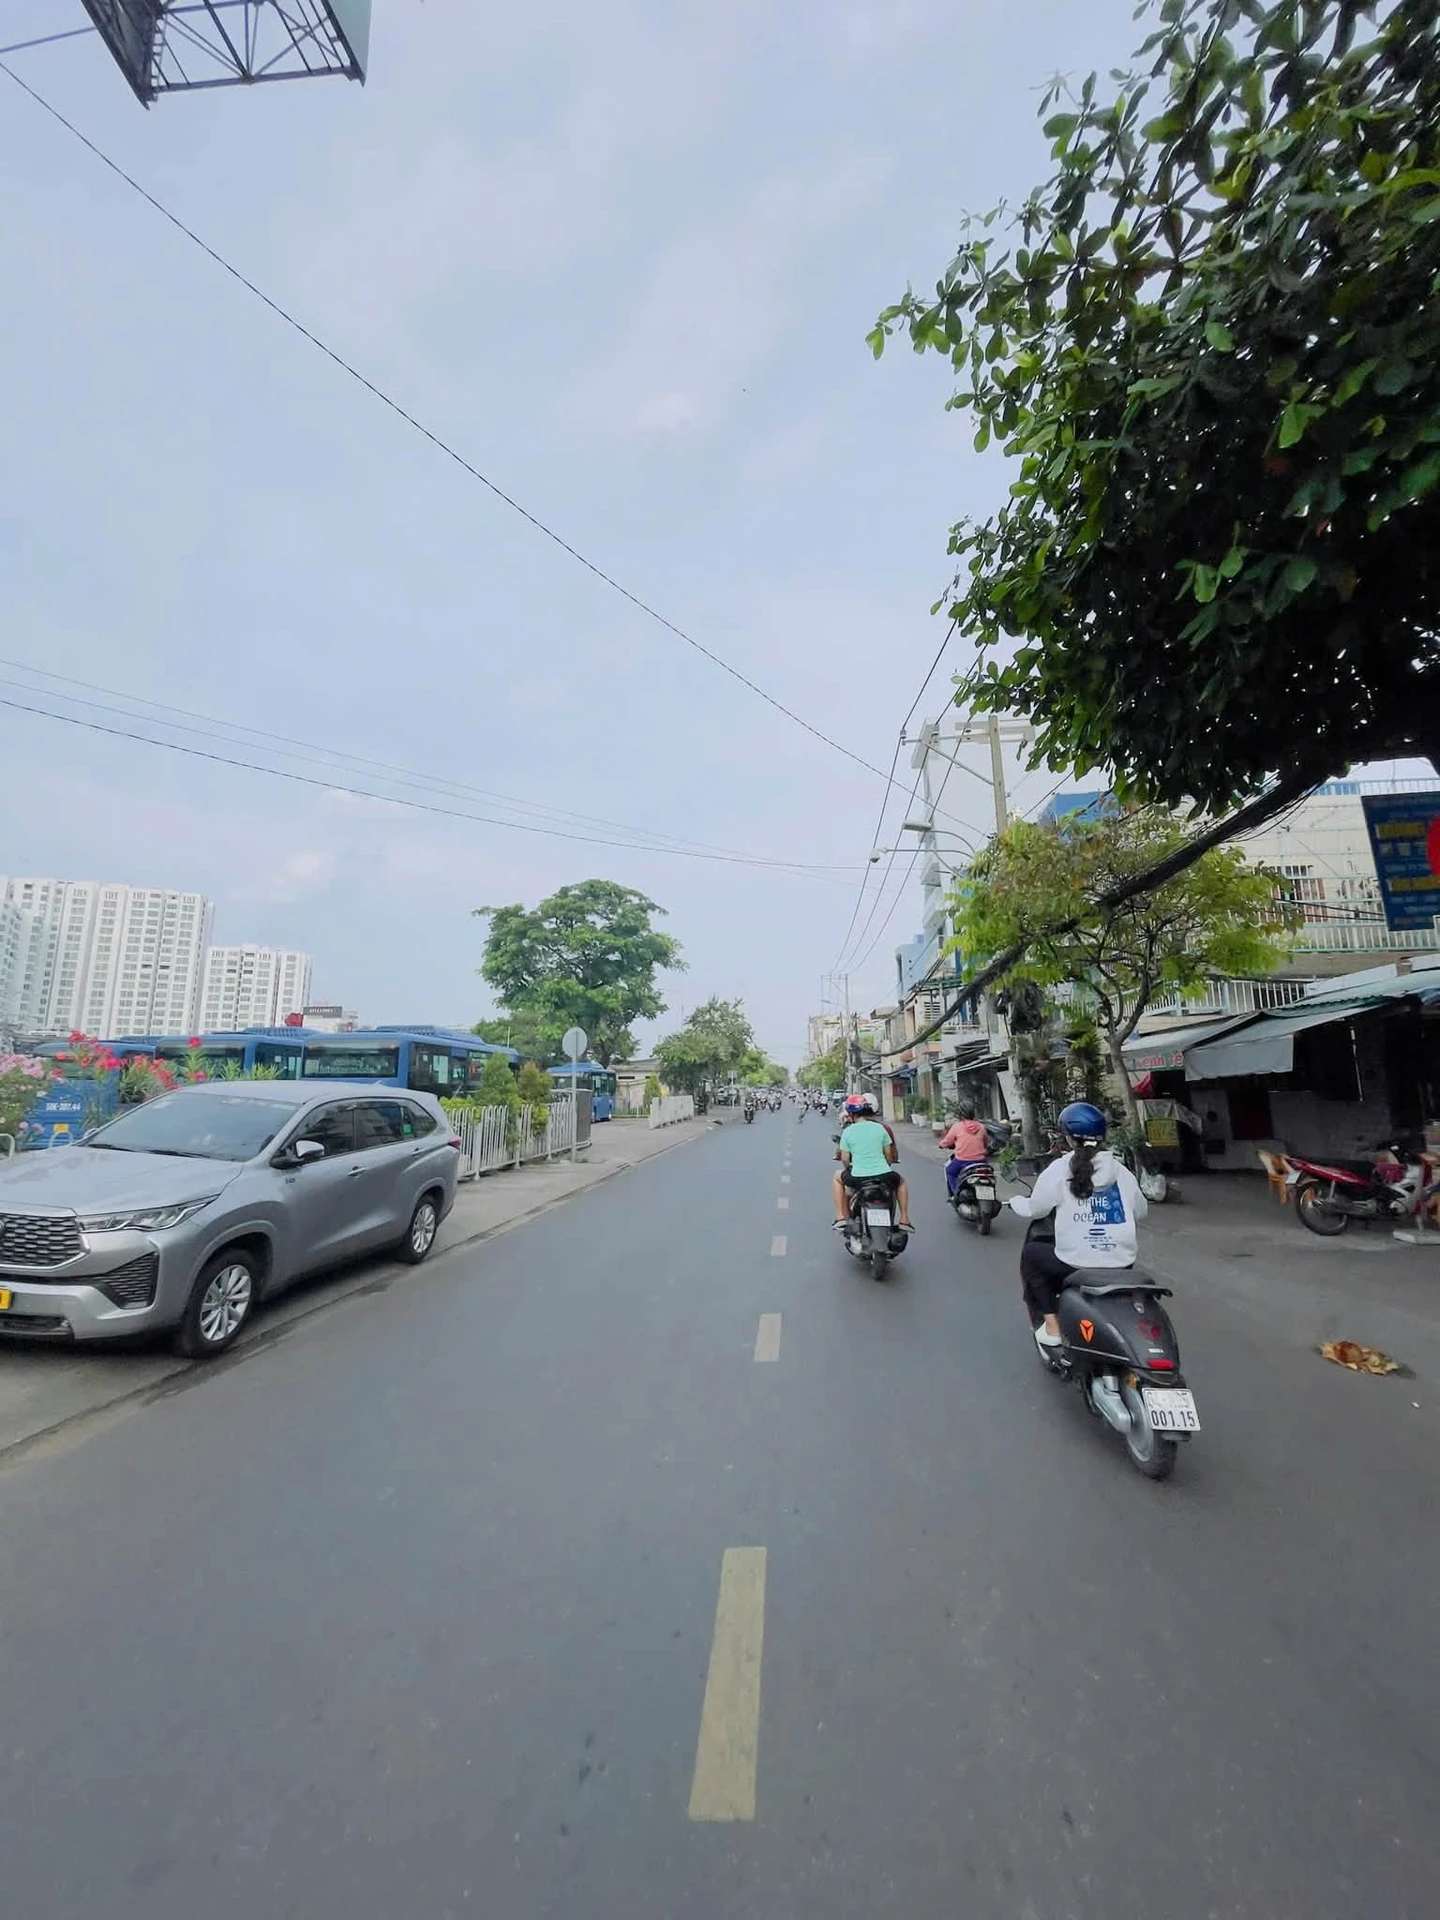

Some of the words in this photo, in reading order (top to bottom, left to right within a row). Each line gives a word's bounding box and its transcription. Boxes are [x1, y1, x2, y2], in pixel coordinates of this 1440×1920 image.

[1090, 1196, 1110, 1207] THE
[1073, 1212, 1108, 1222] OCEAN
[1151, 1409, 1196, 1428] 001.15
